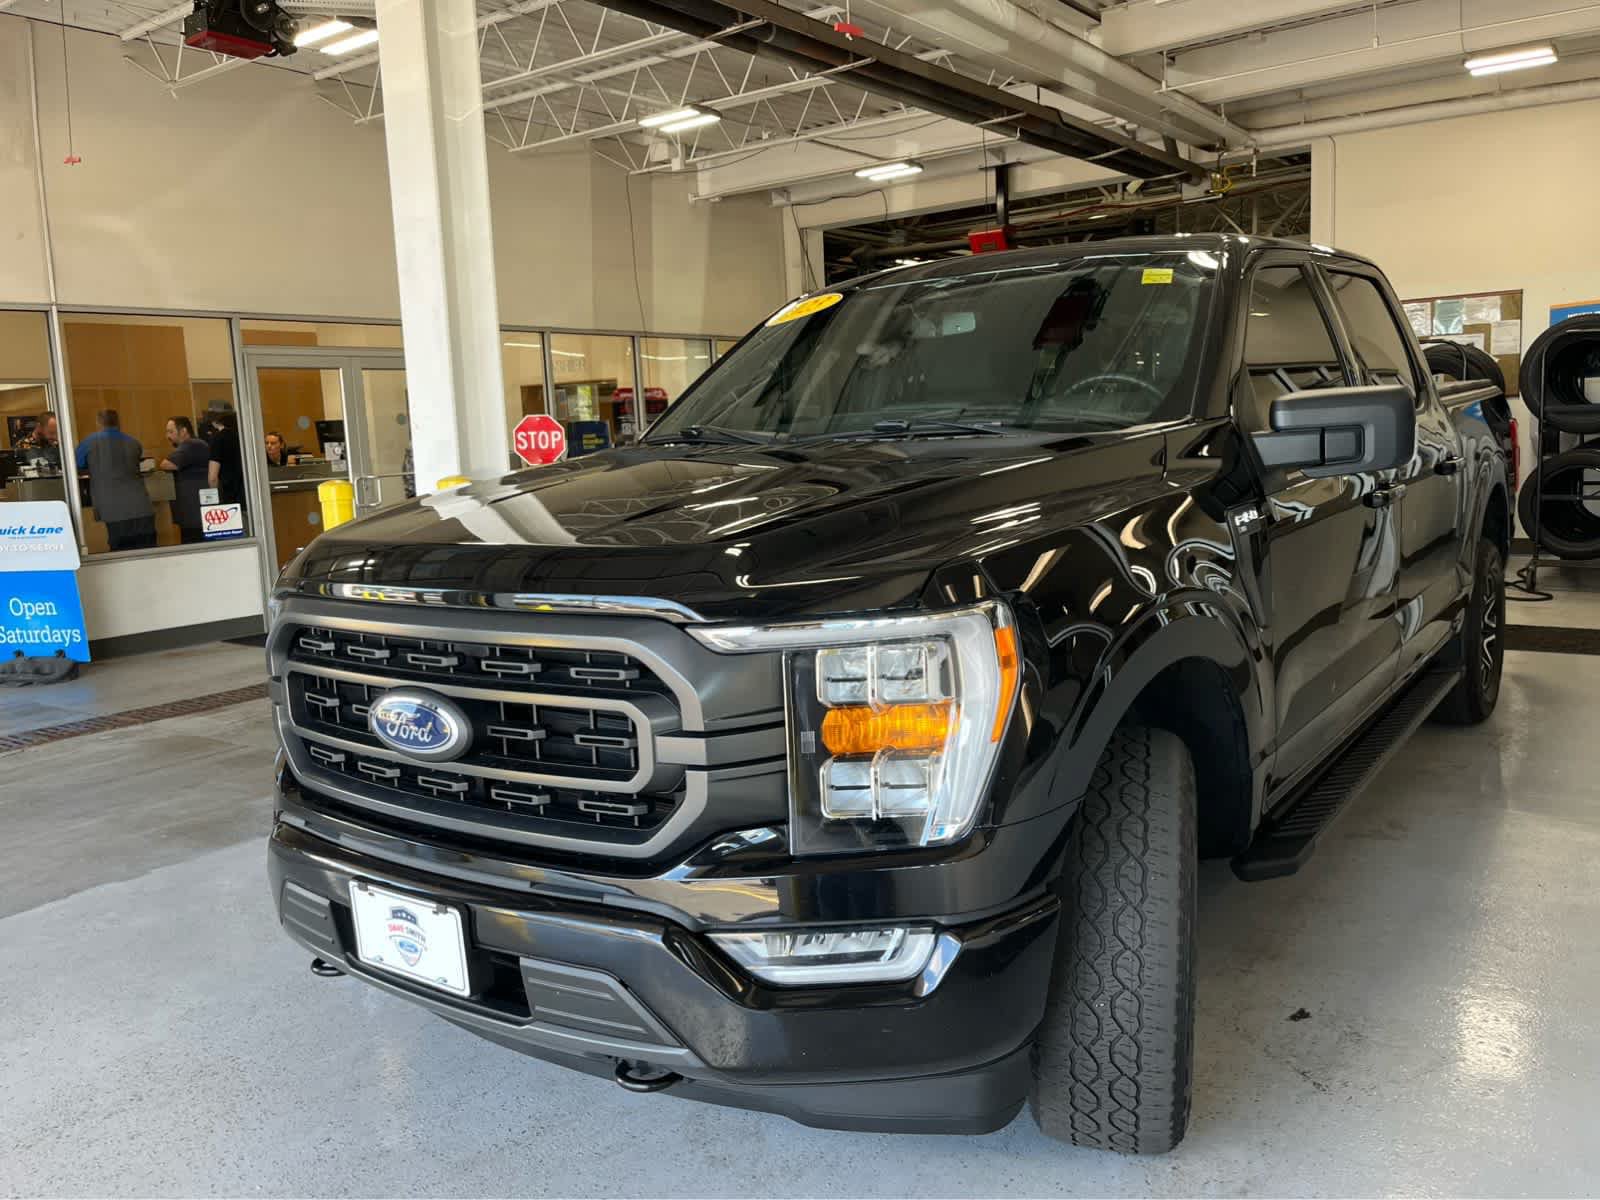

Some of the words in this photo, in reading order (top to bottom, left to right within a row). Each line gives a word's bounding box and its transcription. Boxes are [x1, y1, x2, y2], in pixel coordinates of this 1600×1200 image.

[516, 430, 563, 450] STOP
[205, 510, 228, 523] AAA
[0, 525, 26, 535] uick
[29, 524, 64, 535] Lane
[9, 597, 58, 620] Open
[0, 625, 82, 647] Saturdays
[386, 709, 433, 743] Ford
